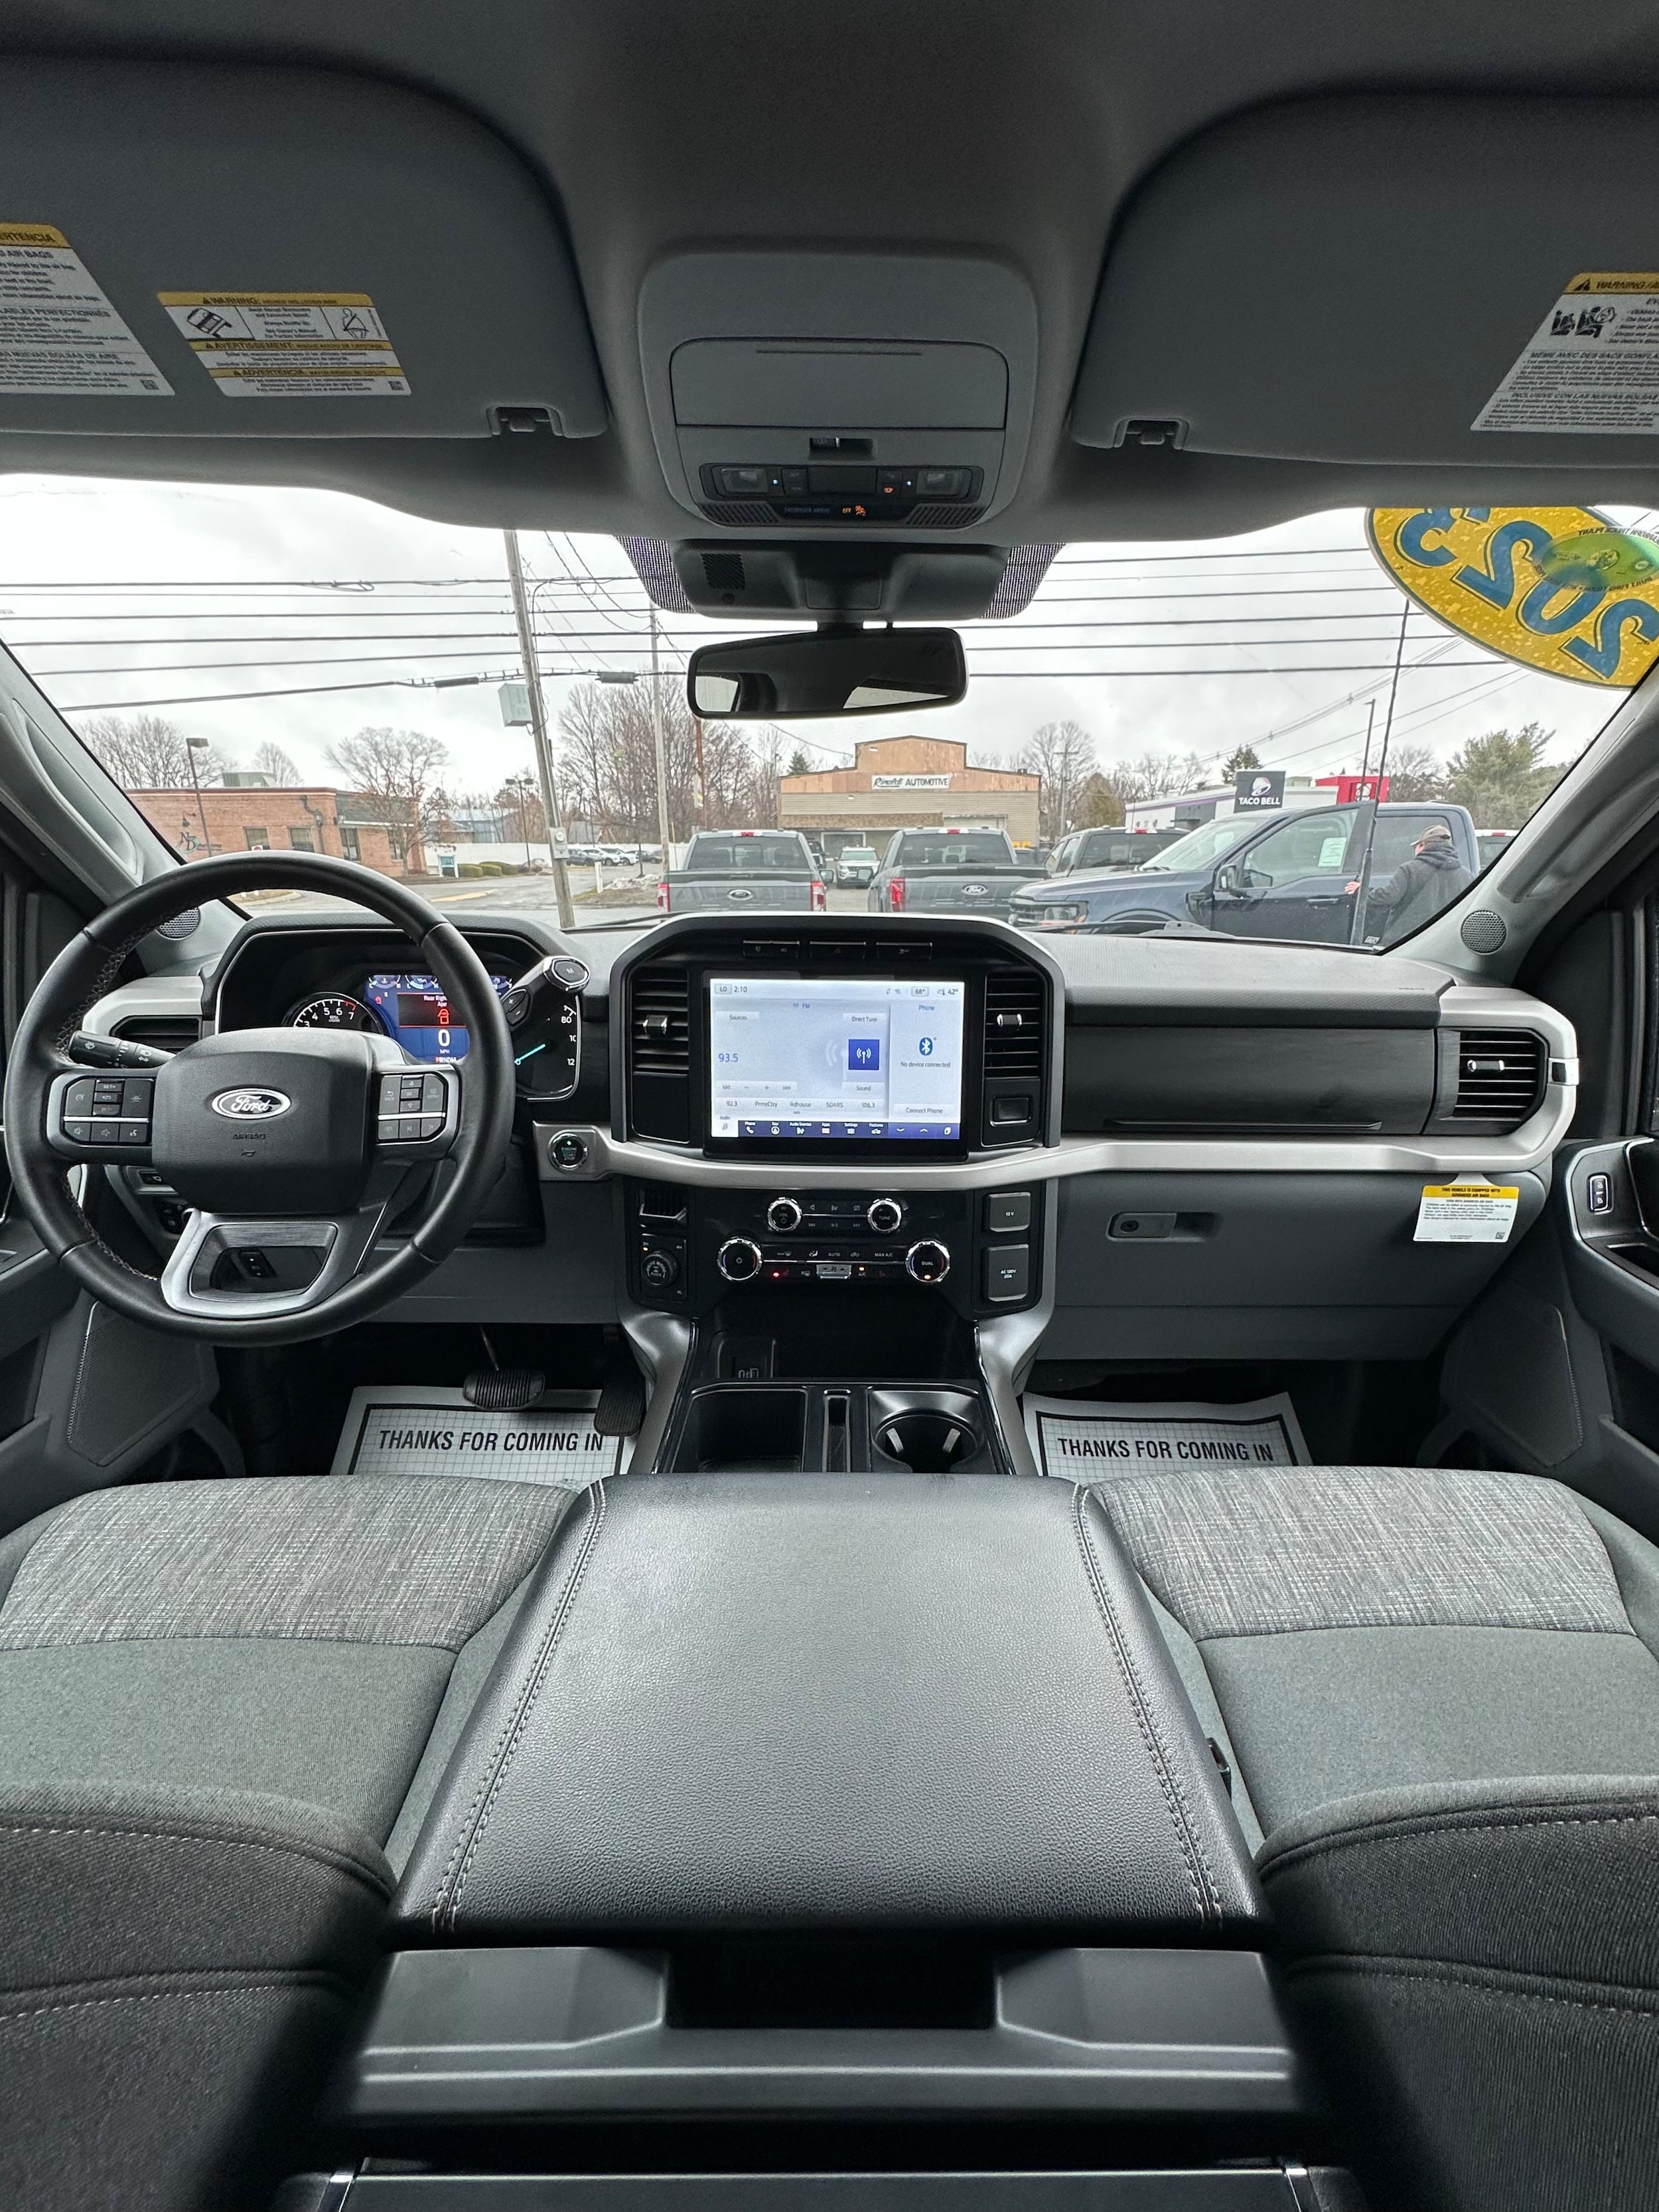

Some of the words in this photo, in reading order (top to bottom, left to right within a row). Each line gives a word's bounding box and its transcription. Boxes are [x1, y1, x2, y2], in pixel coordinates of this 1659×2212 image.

[905, 778, 948, 786] AUTOMOTIVE
[1239, 797, 1260, 805] TACO
[438, 1029, 451, 1047] 0
[719, 1053, 739, 1063] 93.5
[231, 1095, 271, 1112] Ford
[379, 1429, 454, 1450] THANKS
[459, 1432, 498, 1451] FOR
[503, 1432, 579, 1451] COMING
[584, 1434, 603, 1451] IN
[1058, 1437, 1130, 1458] THANKS
[1135, 1440, 1173, 1458] FOR
[1177, 1442, 1249, 1461] COMING
[1253, 1444, 1274, 1462] IN
